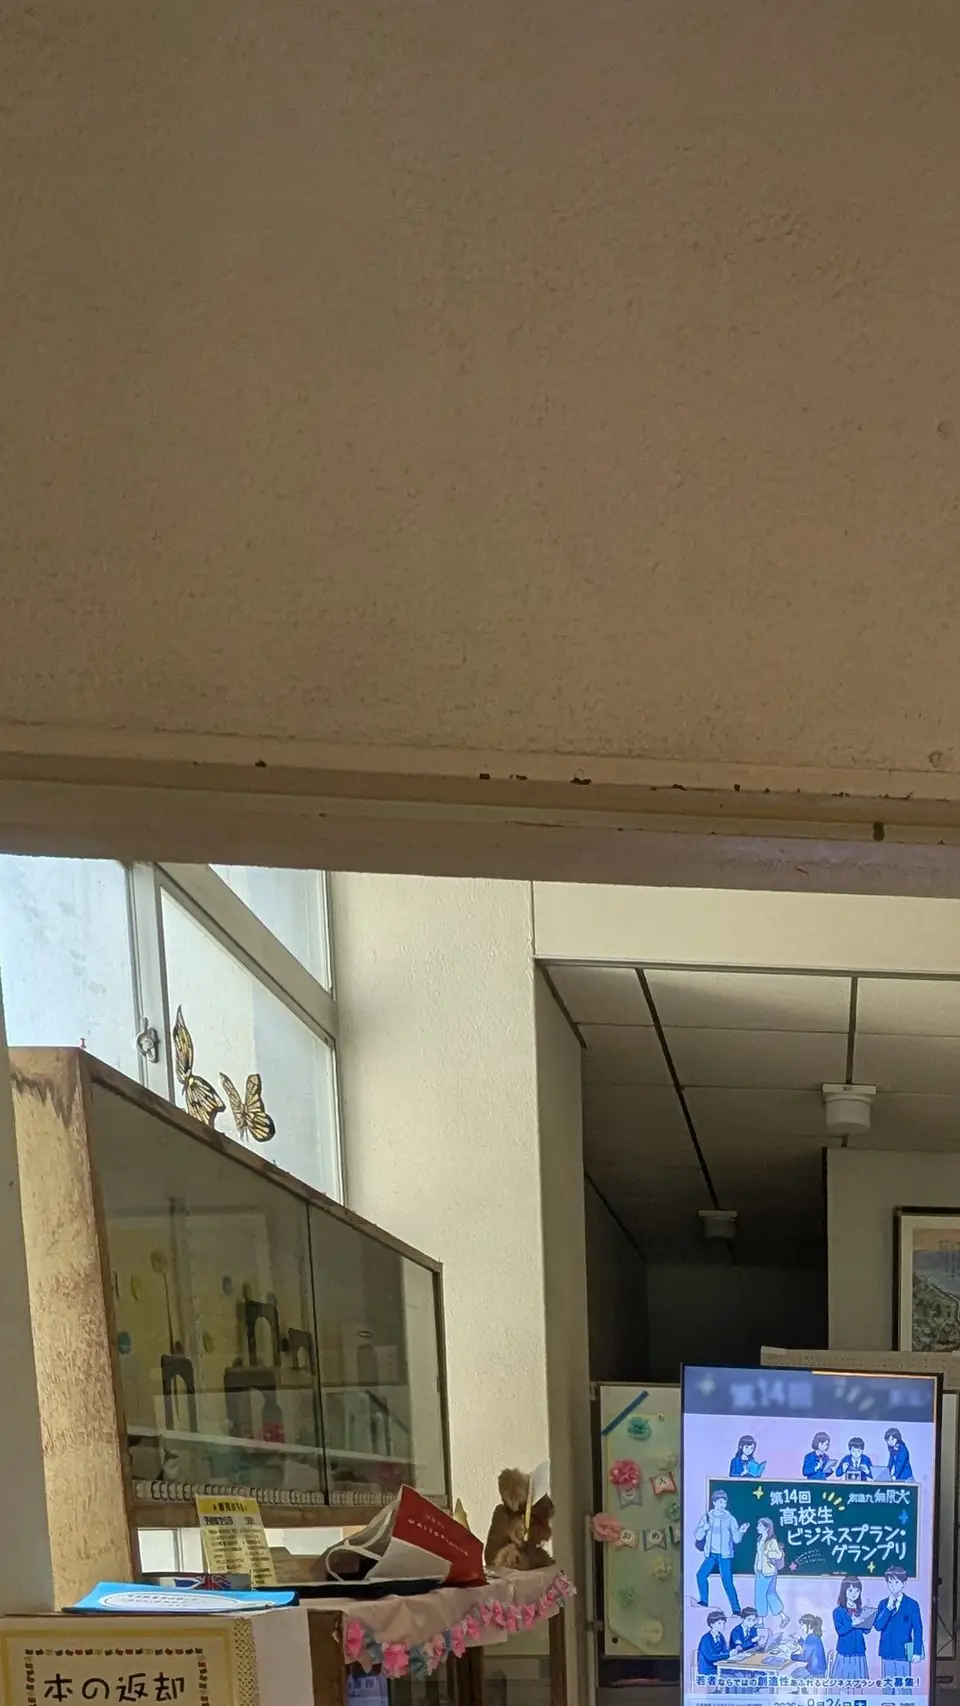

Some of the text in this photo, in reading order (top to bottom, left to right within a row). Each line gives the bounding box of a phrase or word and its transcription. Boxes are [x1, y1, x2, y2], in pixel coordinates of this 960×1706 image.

[769, 1488, 811, 1506] 第14回
[779, 1506, 835, 1527] 高校生
[831, 1541, 907, 1564] グランプリ
[44, 1671, 185, 1703] 本の返却
